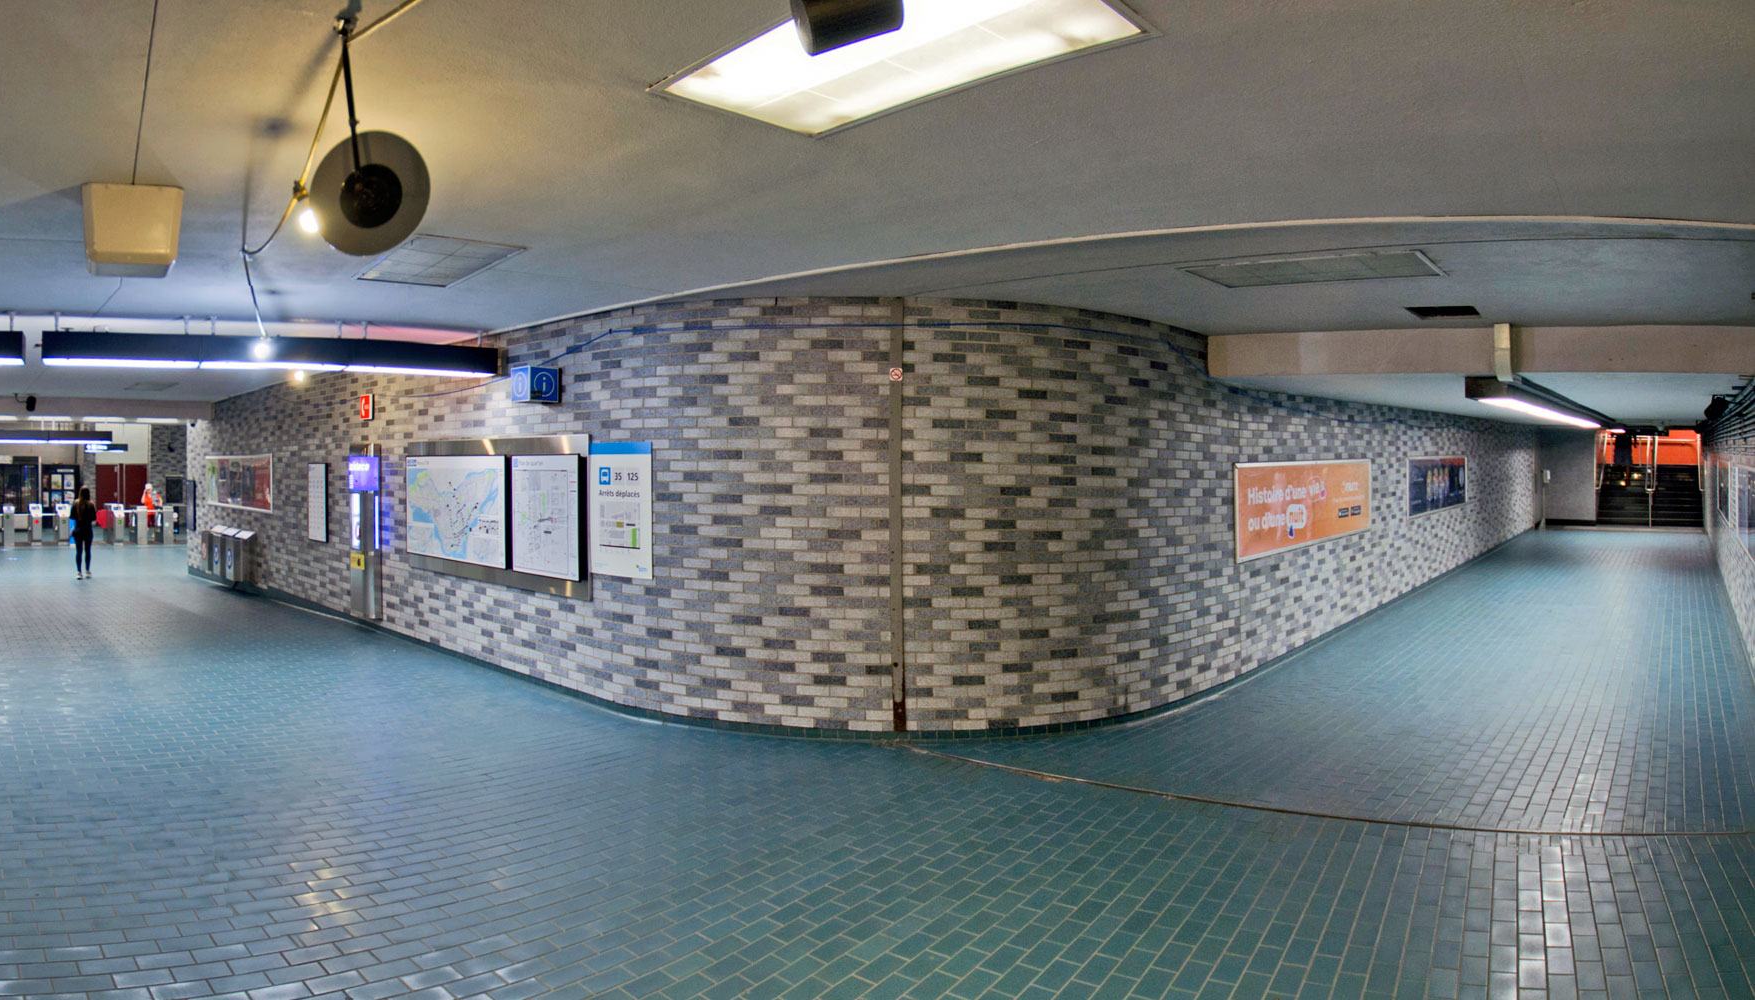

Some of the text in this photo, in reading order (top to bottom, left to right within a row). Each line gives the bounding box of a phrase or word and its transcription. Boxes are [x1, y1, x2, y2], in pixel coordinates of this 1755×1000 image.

[614, 472, 639, 481] 35 125
[615, 490, 640, 499] déplacés
[1247, 480, 1320, 505] Histoire d'une vie
[1248, 508, 1305, 532] ou d'une nuit
